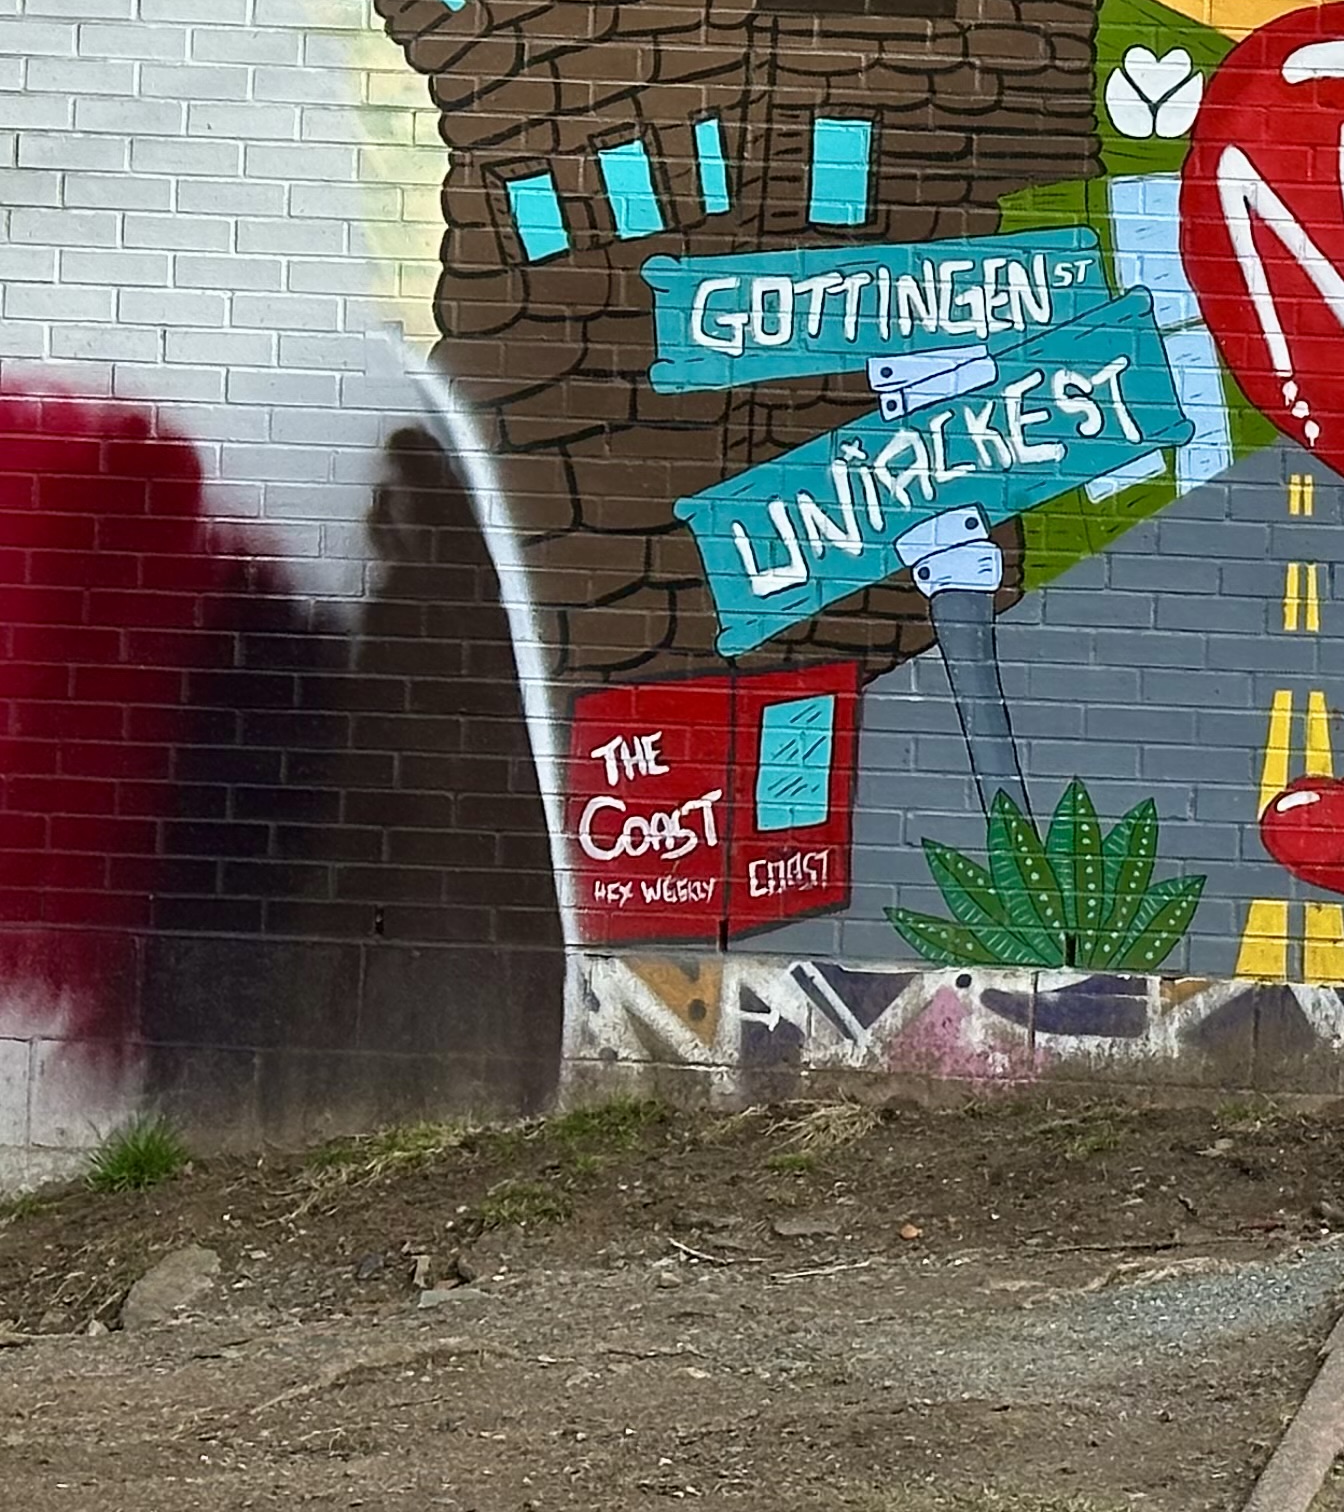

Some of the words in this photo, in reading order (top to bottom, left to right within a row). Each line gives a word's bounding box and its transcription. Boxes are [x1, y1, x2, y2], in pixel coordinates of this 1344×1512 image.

[691, 254, 1053, 356] GOTTINGEN
[1052, 259, 1092, 287] ST
[591, 731, 669, 786] THE
[579, 788, 722, 860] COAST
